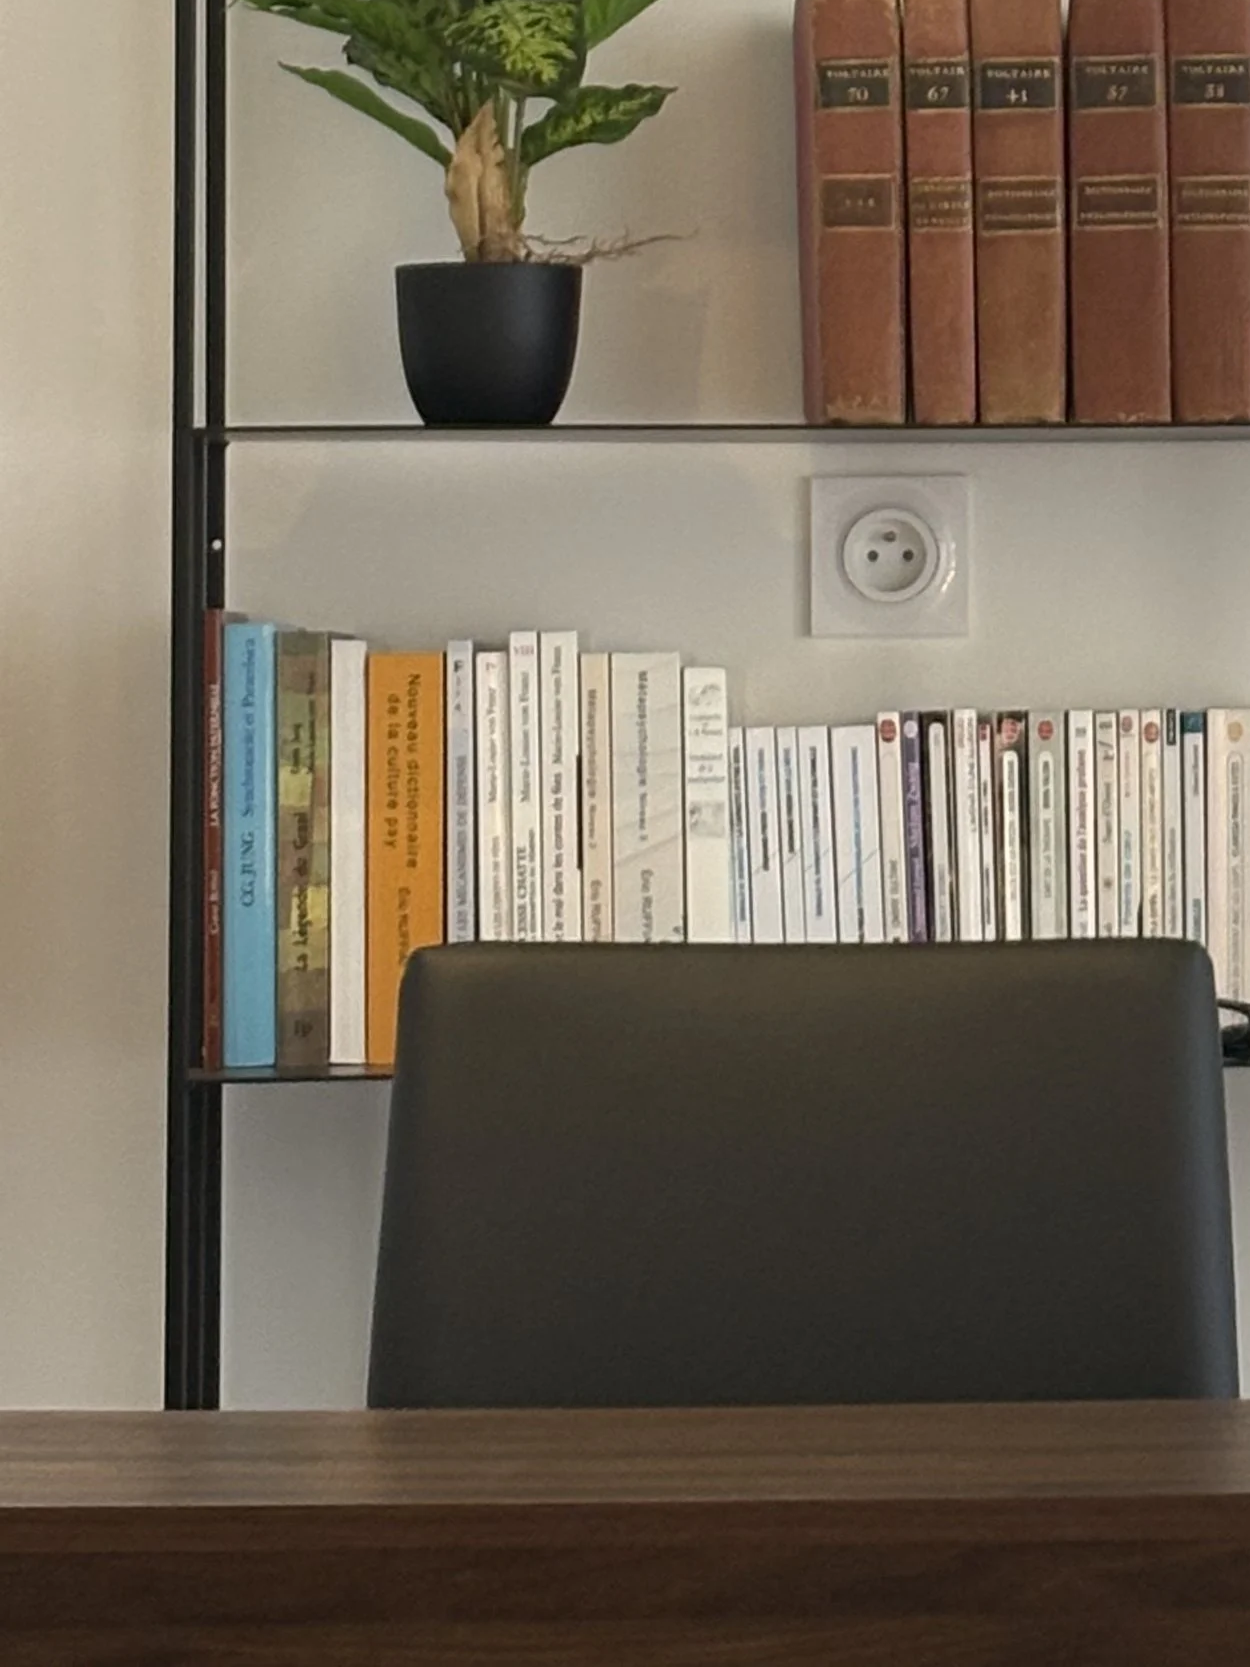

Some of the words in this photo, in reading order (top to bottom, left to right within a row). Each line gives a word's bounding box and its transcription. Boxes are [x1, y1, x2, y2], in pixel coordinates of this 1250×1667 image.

[826, 68, 890, 79] VOLTAIRE
[986, 68, 1051, 79] VOLTAIRE
[1085, 64, 1150, 75] VOLTAIRE
[1181, 64, 1246, 75] VOLTAIRE
[847, 87, 869, 102] 70
[927, 85, 950, 102] 67
[387, 692, 402, 717] de
[406, 673, 421, 754] Nouveau
[387, 722, 402, 740] la
[386, 745, 402, 811] culture
[405, 759, 421, 870] dictionnaire
[293, 811, 309, 851] Graal
[239, 832, 256, 877] JUNG
[293, 953, 309, 973] La
